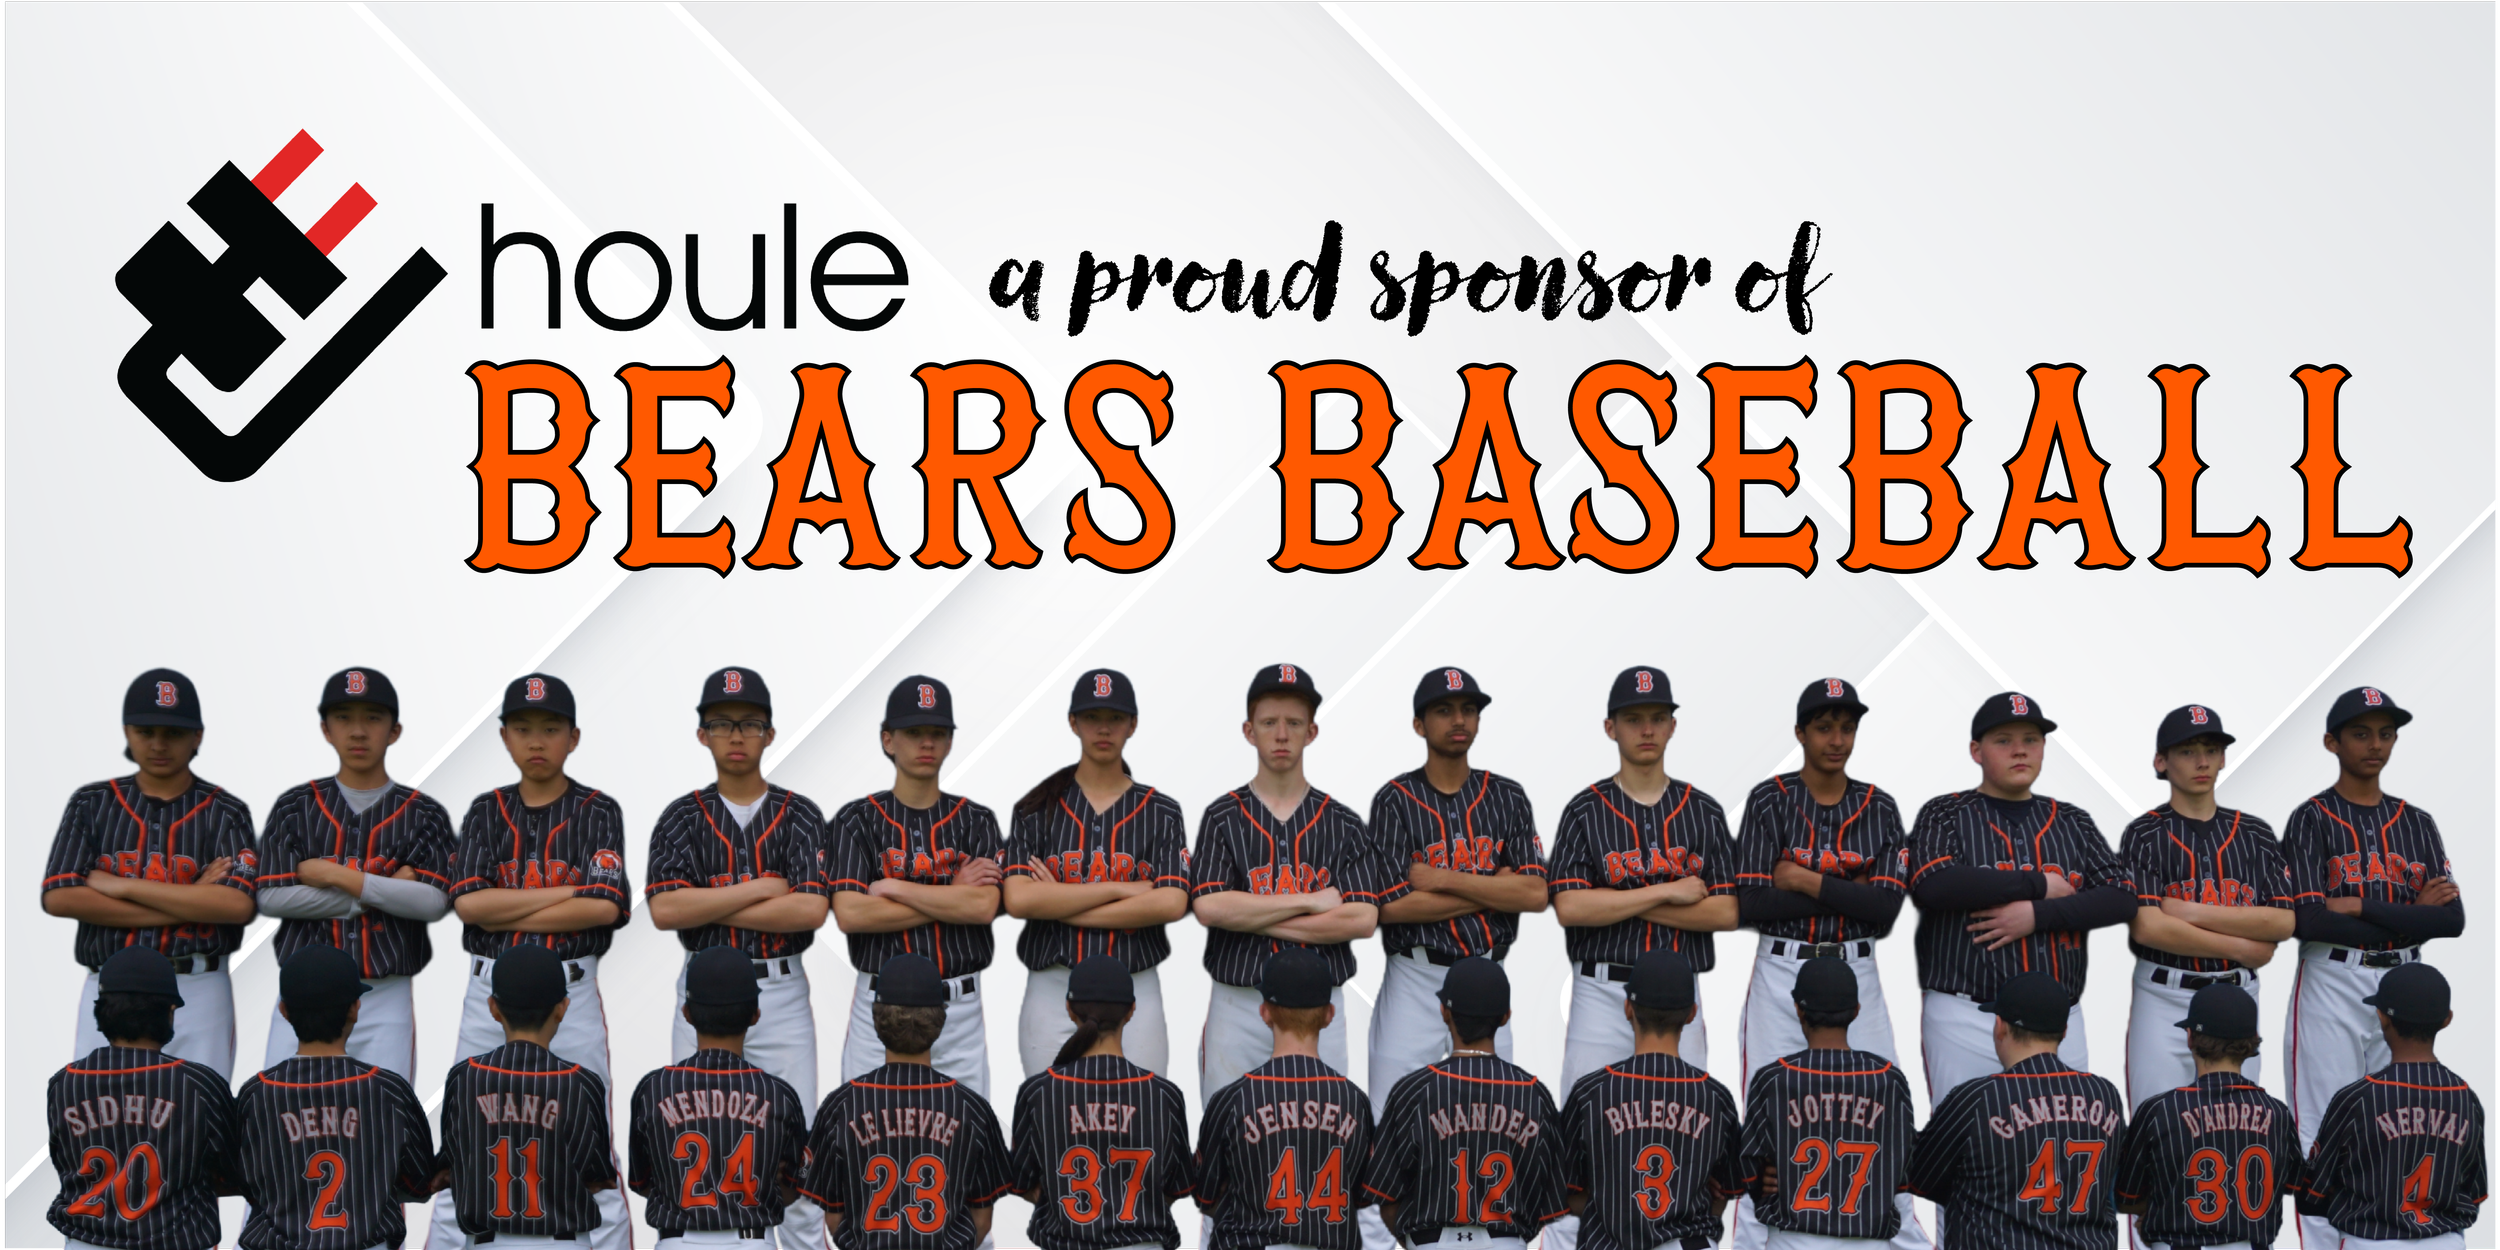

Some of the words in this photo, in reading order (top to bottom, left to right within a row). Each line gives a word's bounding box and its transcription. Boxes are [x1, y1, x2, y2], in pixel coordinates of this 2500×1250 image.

[481, 203, 909, 332] houle
[988, 258, 1045, 322] a
[1066, 219, 1344, 338] proud
[1369, 250, 1712, 337] sponsor
[1734, 220, 1833, 336] of
[463, 354, 1176, 580] BEARS
[1266, 354, 2414, 580] BASEBALL
[156, 681, 178, 706] B
[345, 671, 367, 694] B
[525, 678, 546, 700] B
[723, 670, 742, 693] B
[1093, 674, 1112, 697] B
[1279, 664, 1297, 684] B
[1445, 669, 1463, 690] B
[1636, 671, 1653, 692] B
[1825, 678, 1844, 697] B
[918, 684, 936, 708] B
[2010, 694, 2028, 715] B
[2189, 706, 2208, 724] B
[2363, 688, 2382, 705] B
[63, 1095, 175, 1136] SIDHU
[280, 1106, 359, 1142] DENG
[476, 1093, 559, 1130] WANG
[658, 1089, 770, 1129] MENDOZA
[849, 1110, 881, 1147] LE
[881, 1107, 960, 1148] LIEVRE
[1070, 1102, 1136, 1134] AKEY
[1243, 1100, 1357, 1144] JENSEN
[1430, 1103, 1539, 1148] MANDER
[1604, 1099, 1711, 1139] BILESKY
[1787, 1092, 1885, 1129] JOTTEY
[1988, 1095, 2120, 1140] CAMERON
[2181, 1102, 2273, 1138] D'ANDREA
[66, 1142, 166, 1221] 20
[302, 1150, 349, 1231] 2
[487, 1136, 546, 1219] 11
[671, 1131, 760, 1210] 24
[1057, 1145, 1155, 1225] 37
[1264, 1146, 1349, 1226] 44
[1450, 1148, 1516, 1226] 12
[1632, 1143, 1679, 1221] 3
[1790, 1137, 1881, 1215] 27
[2017, 1138, 2107, 1214] 47
[2184, 1144, 2275, 1225] 30
[2400, 1153, 2436, 1225] 4
[862, 1154, 949, 1234] 23
